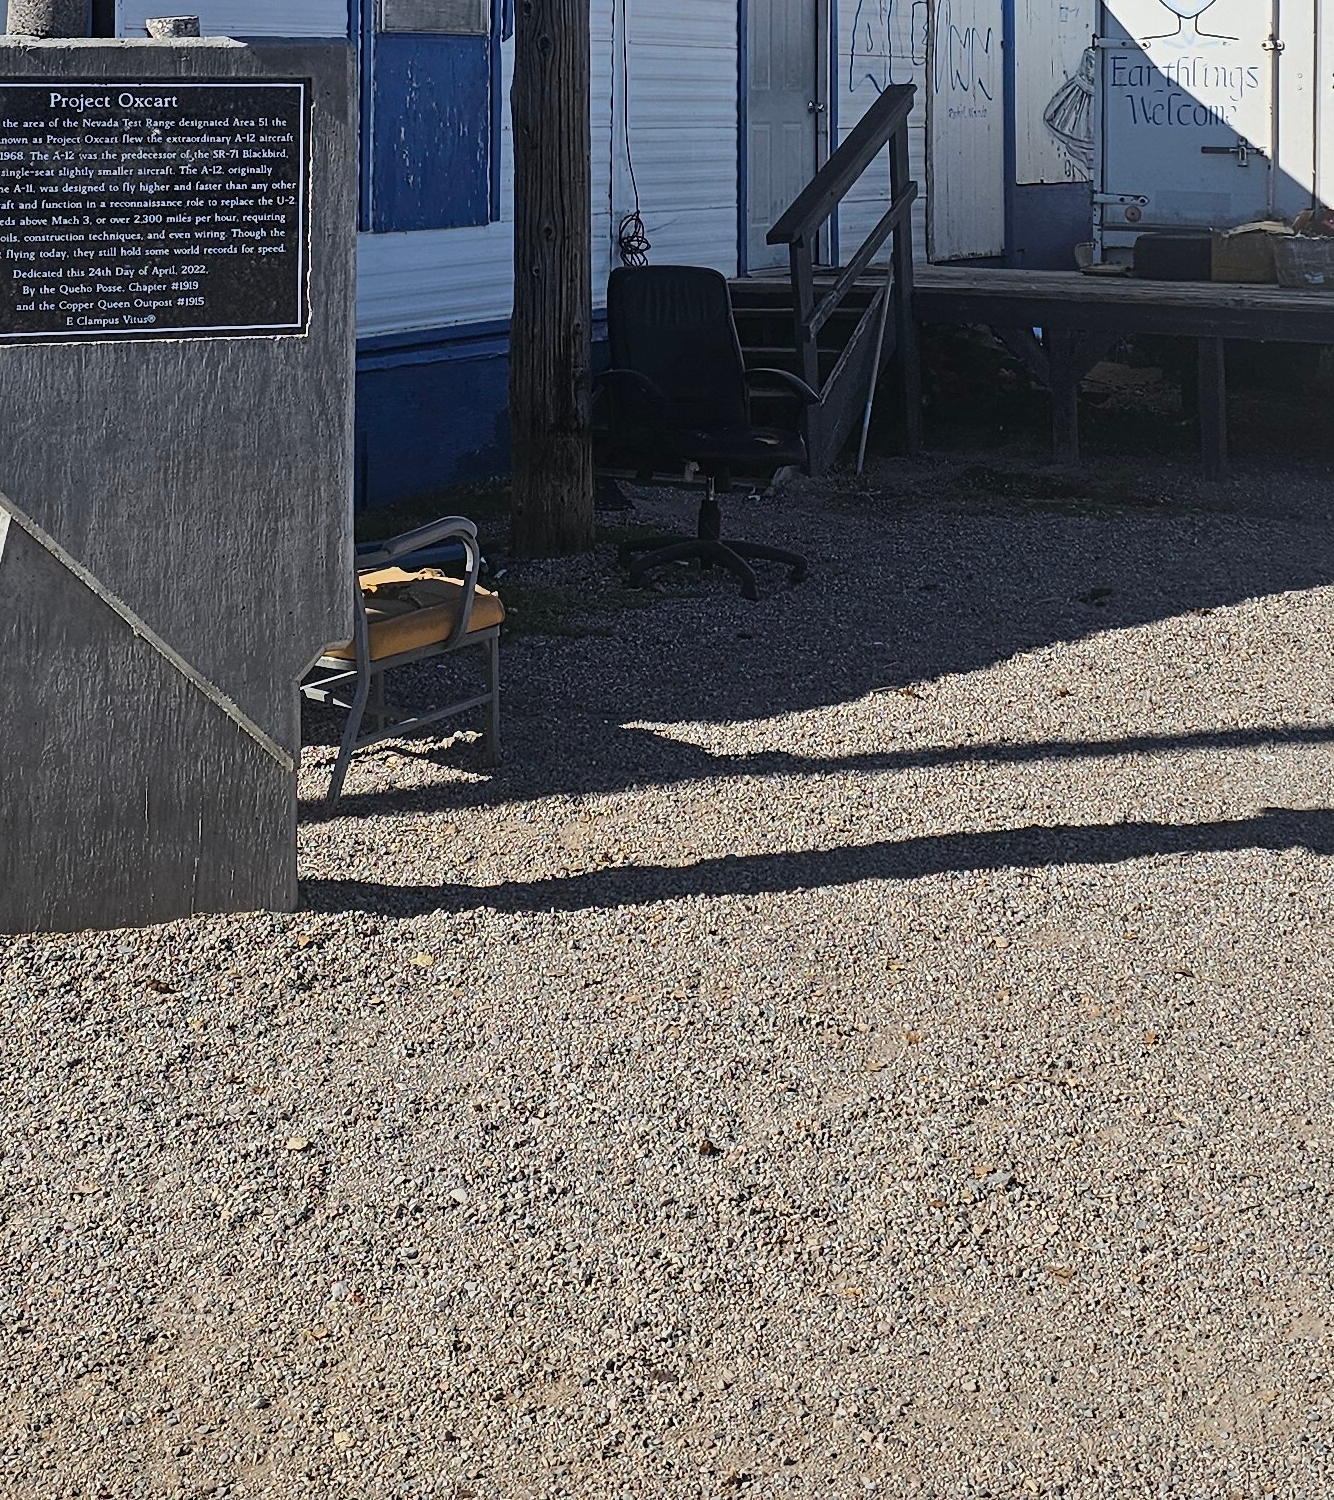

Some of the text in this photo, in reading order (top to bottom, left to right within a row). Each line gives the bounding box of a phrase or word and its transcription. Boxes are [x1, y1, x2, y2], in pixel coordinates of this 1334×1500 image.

[1110, 56, 1260, 102] Earthlings
[49, 92, 178, 112] Project Oxcart
[1124, 89, 1237, 127] Welcome
[2, 118, 18, 127] the
[48, 117, 59, 127] of
[62, 117, 78, 127] the
[82, 117, 119, 127] Nevada
[121, 118, 141, 127] Test
[145, 117, 175, 129] Range
[178, 117, 229, 129] designated
[232, 117, 255, 126] Area
[258, 117, 267, 126] 51
[271, 117, 286, 126] the
[46, 134, 80, 146] Project
[84, 134, 118, 143] Oxcart
[122, 133, 143, 143] flew
[146, 134, 162, 142] the
[165, 133, 231, 145] extraordinary
[234, 133, 255, 142] A-12
[259, 132, 293, 142] aircraft
[28, 150, 49, 160] The
[52, 150, 74, 160] A-12
[101, 150, 117, 159] the
[120, 149, 176, 162] predecessor
[179, 149, 191, 158] of
[193, 149, 209, 158] the
[212, 148, 239, 158] SR-71
[0, 166, 54, 179] single-seat
[58, 166, 94, 178] slightly
[97, 165, 133, 175] smaller
[137, 165, 175, 175] aircraft.
[178, 164, 197, 174] The
[227, 164, 272, 176] originally
[61, 182, 105, 194] designed
[122, 181, 135, 194] fly
[139, 181, 170, 194] higher
[173, 181, 191, 190] and
[195, 180, 222, 190] faster
[225, 180, 247, 190] than
[250, 182, 268, 192] any
[271, 179, 296, 189] other
[18, 199, 37, 209] and
[41, 198, 82, 209] function
[86, 200, 96, 208] in
[109, 198, 182, 208] reconnaissance
[186, 196, 204, 206] role
[220, 196, 254, 208] replace
[257, 195, 273, 205] the
[19, 215, 47, 225] above
[51, 215, 79, 225] Mach
[82, 215, 92, 225] 3,
[165, 212, 191, 222] miles
[194, 215, 211, 225] per
[242, 213, 285, 224] requiring
[23, 232, 84, 242] construction
[88, 229, 143, 243] techniques,
[146, 229, 165, 239] and
[194, 230, 227, 241] wiring.
[230, 227, 266, 240] Though
[269, 227, 285, 236] the
[5, 248, 35, 261] flying
[39, 247, 69, 260] today,
[73, 247, 95, 259] they
[98, 246, 116, 256] still
[120, 246, 141, 256] hold
[173, 244, 199, 254] world
[203, 244, 237, 254] records
[241, 243, 254, 253] for
[257, 243, 286, 255] speed.
[12, 267, 62, 278] Dedicated
[66, 267, 85, 277] this
[88, 266, 111, 276] 24th
[115, 266, 135, 278] Day
[137, 265, 148, 275] of
[22, 285, 35, 297] By
[39, 284, 55, 294] the
[59, 283, 92, 295] Queho
[128, 281, 166, 294] Chapter
[170, 280, 198, 290] #1919
[15, 296, 204, 312] and the Copper Queen Outpost #1915
[66, 316, 73, 325] E
[76, 314, 119, 326] Clampus
